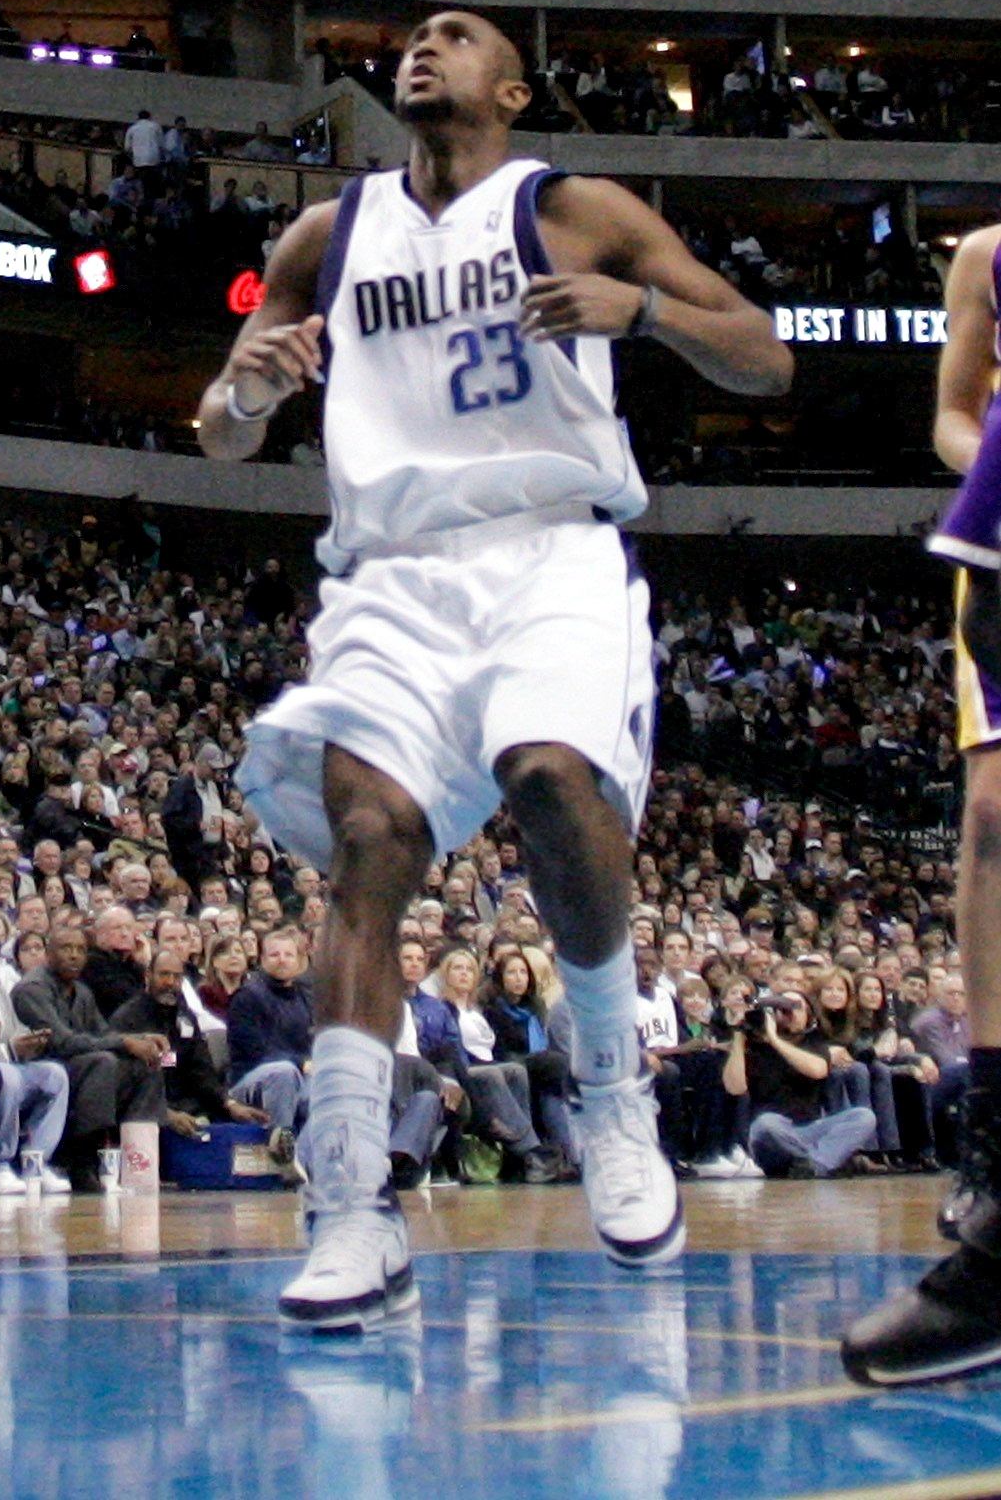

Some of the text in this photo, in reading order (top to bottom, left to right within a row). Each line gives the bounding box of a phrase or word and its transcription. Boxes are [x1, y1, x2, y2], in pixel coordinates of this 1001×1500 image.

[355, 248, 518, 338] DALLAS
[775, 307, 845, 342] BEST
[856, 308, 887, 342] IN
[447, 321, 532, 415] 23
